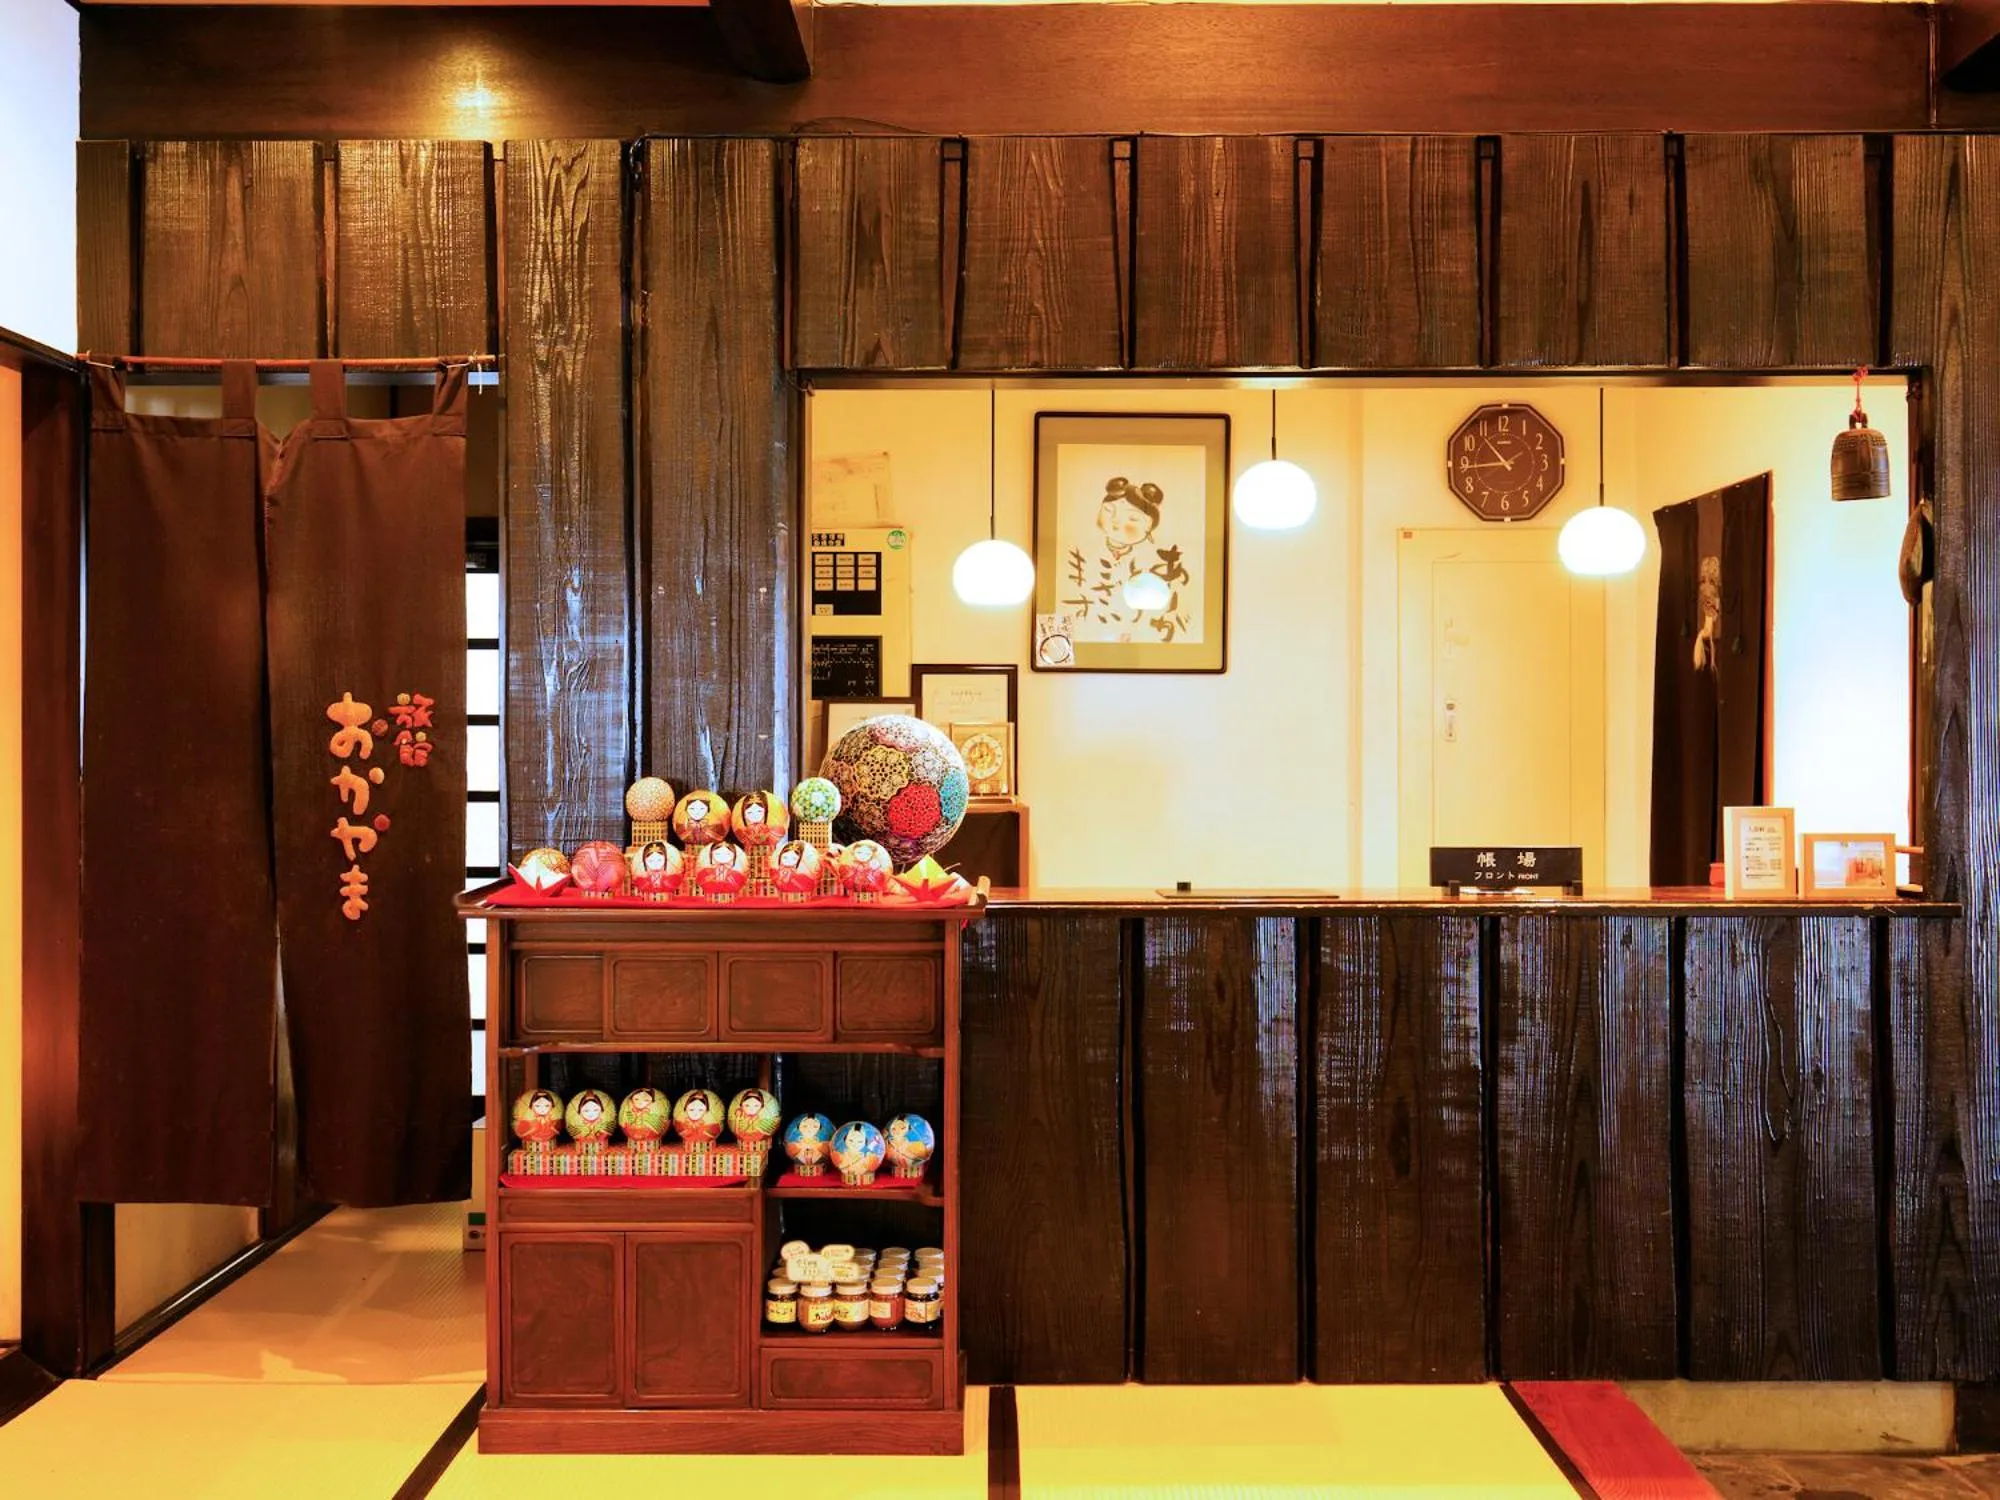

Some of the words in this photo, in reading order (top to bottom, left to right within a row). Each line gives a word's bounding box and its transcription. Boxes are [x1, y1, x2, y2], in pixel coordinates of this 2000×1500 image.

[1479, 419, 1488, 437] 11
[1498, 415, 1509, 432] 12
[1522, 419, 1526, 436] 1
[1464, 435, 1475, 451] 10
[1535, 433, 1543, 450] 2
[1460, 456, 1469, 473] 9
[1541, 454, 1549, 471] 3
[1465, 476, 1474, 493] 8
[1536, 475, 1544, 492] 4
[1481, 492, 1489, 508] 7
[1501, 494, 1510, 511] 6
[1523, 490, 1529, 507] 5
[1474, 870, 1516, 880] フロント
